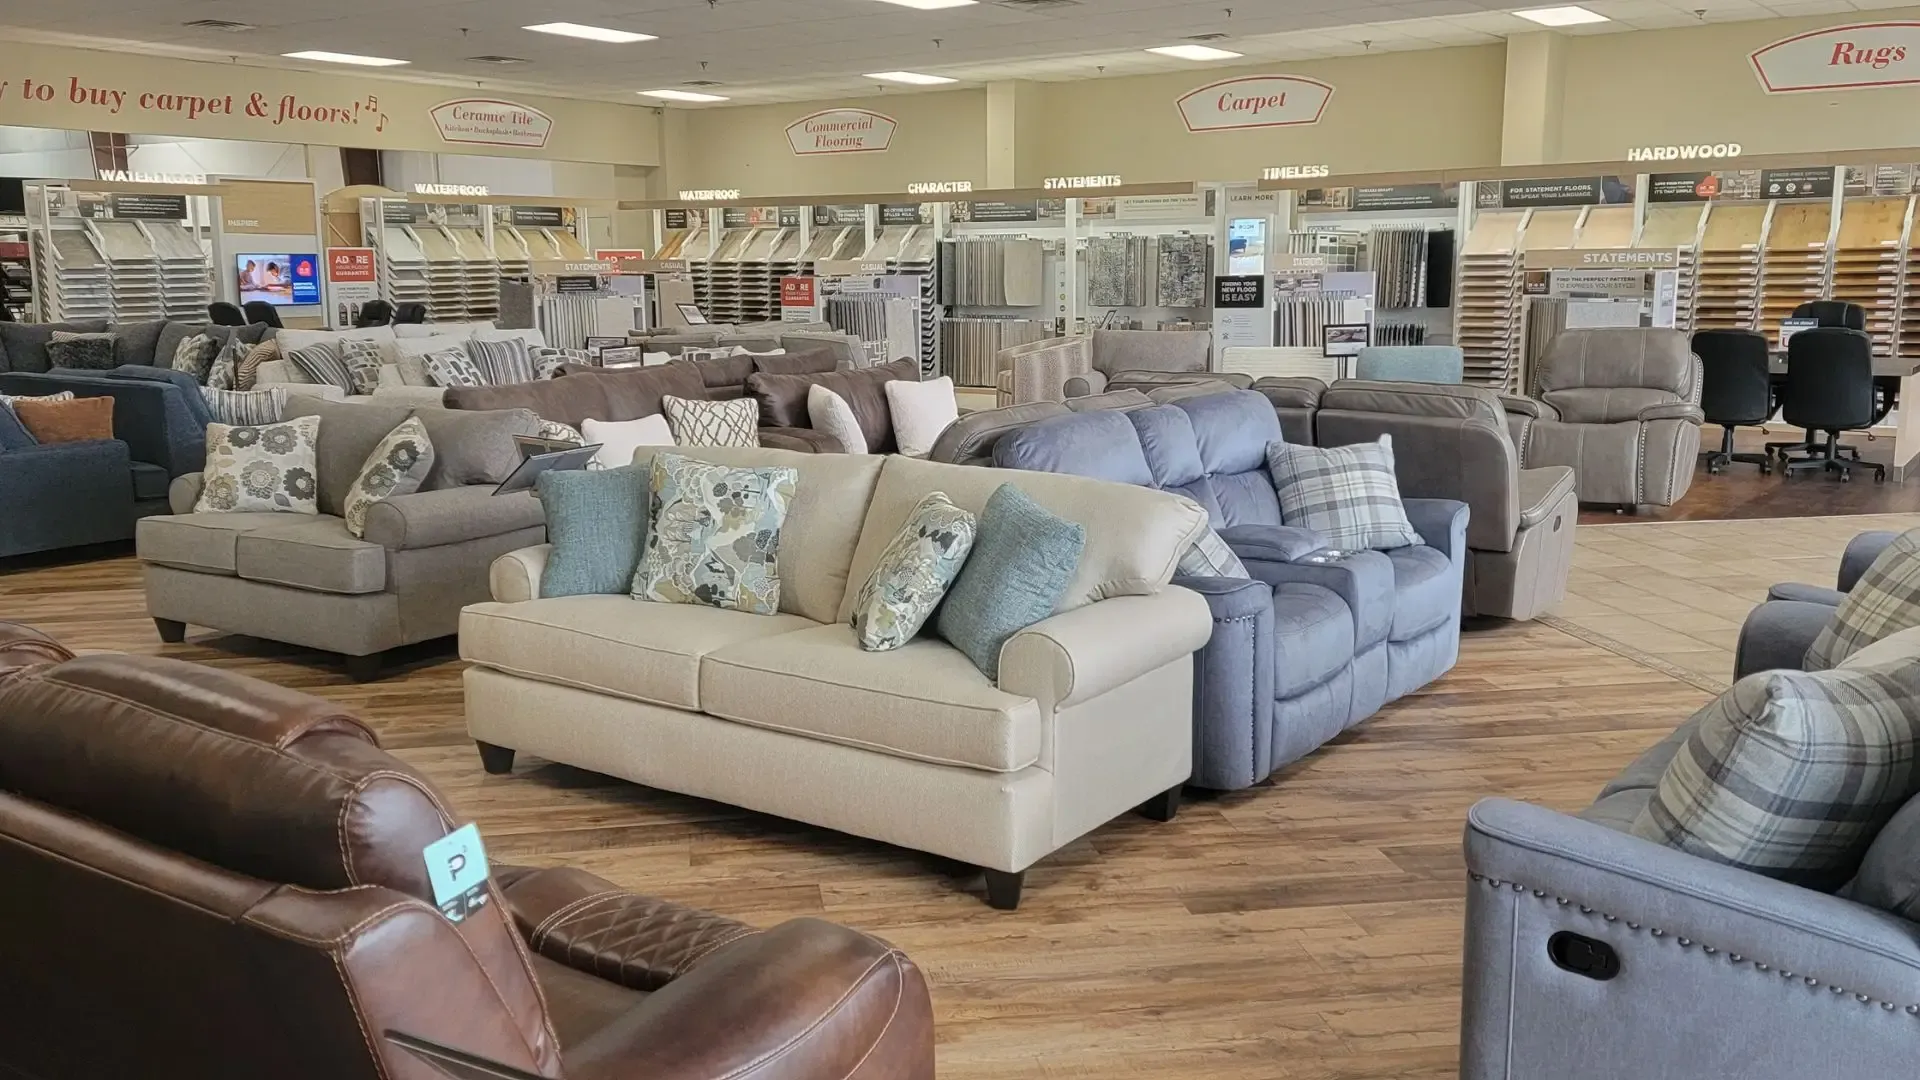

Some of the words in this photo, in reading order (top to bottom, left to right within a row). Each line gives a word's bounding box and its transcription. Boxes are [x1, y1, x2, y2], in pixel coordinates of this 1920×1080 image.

[1828, 41, 1907, 70] Rugs
[23, 79, 55, 101] to
[68, 76, 127, 114] buy
[139, 92, 233, 120] carpet
[245, 92, 268, 117] &
[272, 95, 360, 125] floors!
[1217, 91, 1286, 114] Carpet
[452, 106, 505, 124] Ceramic
[511, 110, 533, 126] Tile
[804, 116, 873, 134] Commercial
[815, 134, 864, 148] Flooring
[1627, 143, 1742, 161] HARDWOOD
[1263, 165, 1329, 180] TIMELESS
[907, 181, 972, 194] CHARACTER
[1043, 175, 1122, 190] STATEMENTS
[1525, 185, 1563, 193] STATEMENT
[1564, 184, 1593, 192] FLOORS.
[414, 183, 489, 196] WATERPROOF
[679, 189, 740, 201] WATERPROOF
[1230, 194, 1252, 202] LEARN
[227, 219, 259, 228] INSPIRE
[335, 255, 369, 265] ADRE
[1583, 252, 1673, 264] STATEMENTS
[565, 263, 611, 272] STATEMENTS
[860, 263, 885, 271] CASUAL
[785, 283, 809, 291] ADRE
[1221, 293, 1231, 302] IS
[1231, 293, 1257, 302] EASY
